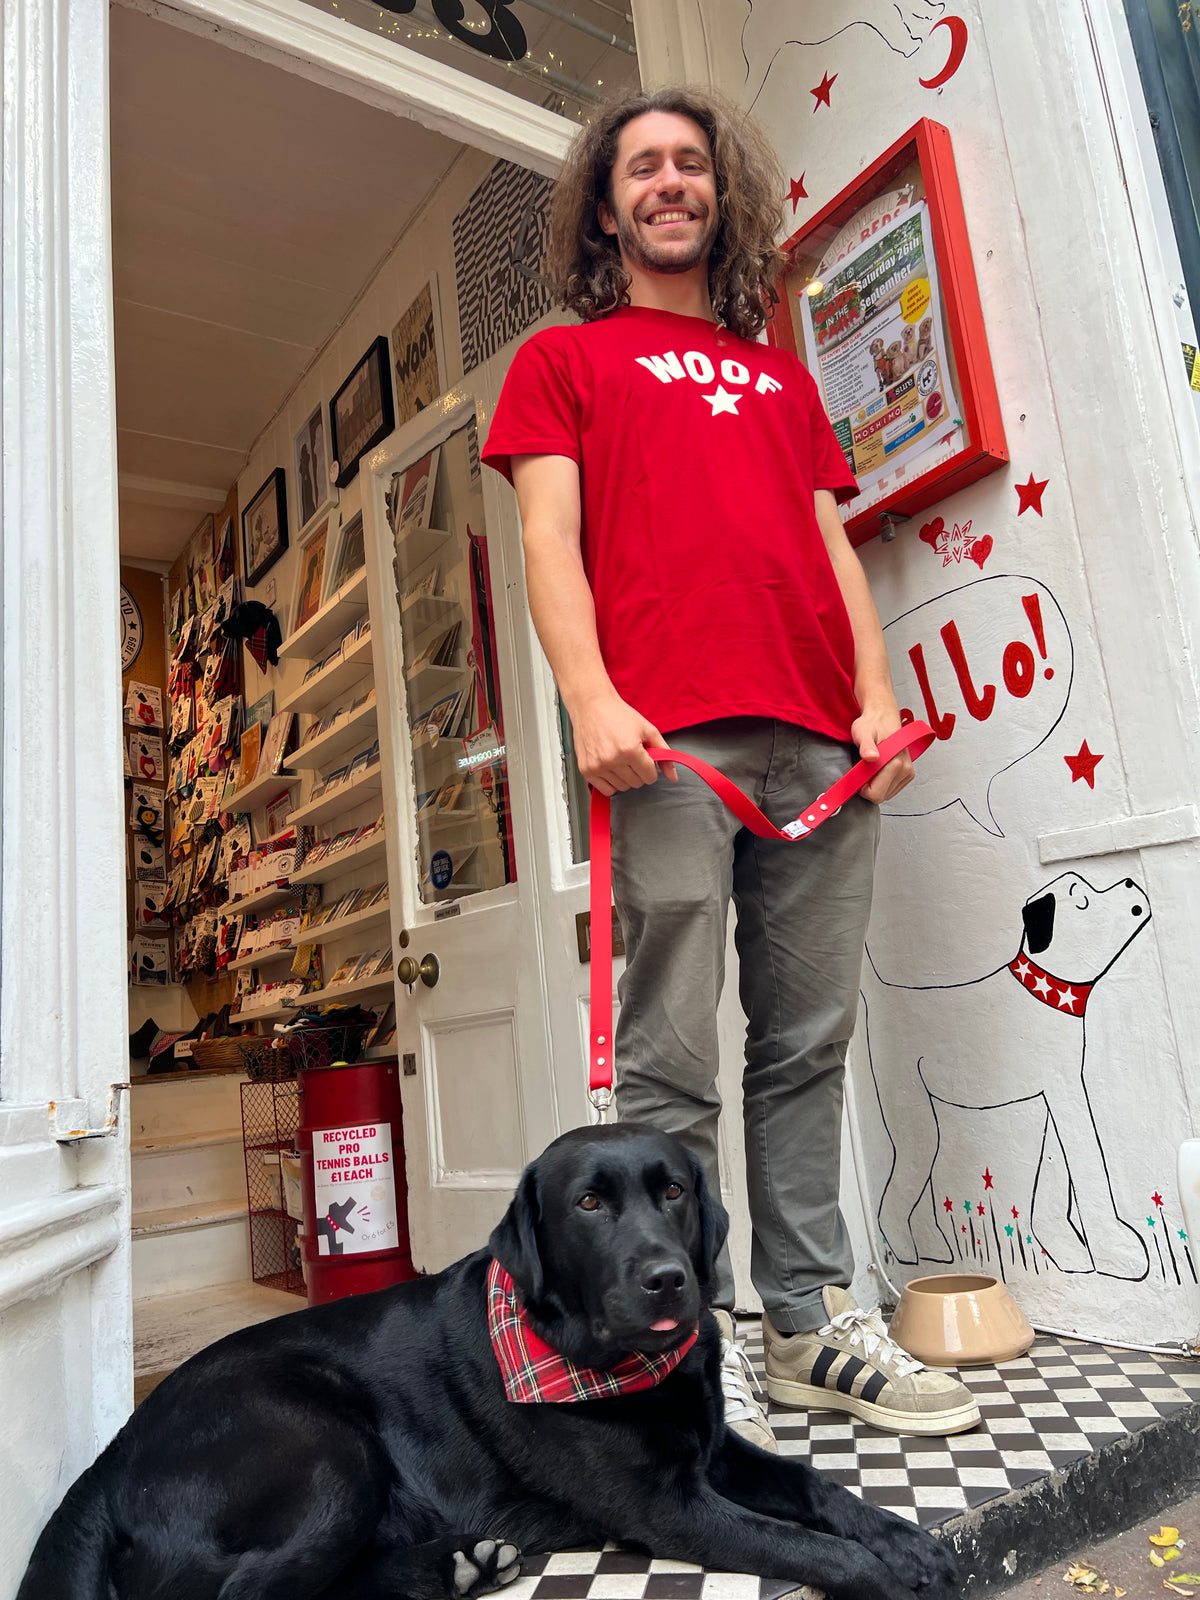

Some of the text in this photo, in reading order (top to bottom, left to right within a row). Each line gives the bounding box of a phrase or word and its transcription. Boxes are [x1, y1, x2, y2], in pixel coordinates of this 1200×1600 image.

[856, 256, 896, 292] Saturday
[896, 237, 919, 260] 26th
[860, 263, 912, 311] September
[814, 286, 856, 326] BARK
[835, 304, 849, 322] THE
[817, 305, 861, 345] PARK
[396, 311, 435, 384] WOOF
[635, 351, 783, 395] WOOF
[895, 378, 913, 396] sure
[855, 408, 901, 441] MOSHIMO
[124, 637, 137, 655] 1999
[323, 1127, 376, 1143] RECYCLED
[317, 1152, 389, 1170] TENNIS BALLS
[339, 1143, 360, 1154] PRO
[331, 1172, 342, 1182] £1
[344, 1168, 373, 1181] EACH
